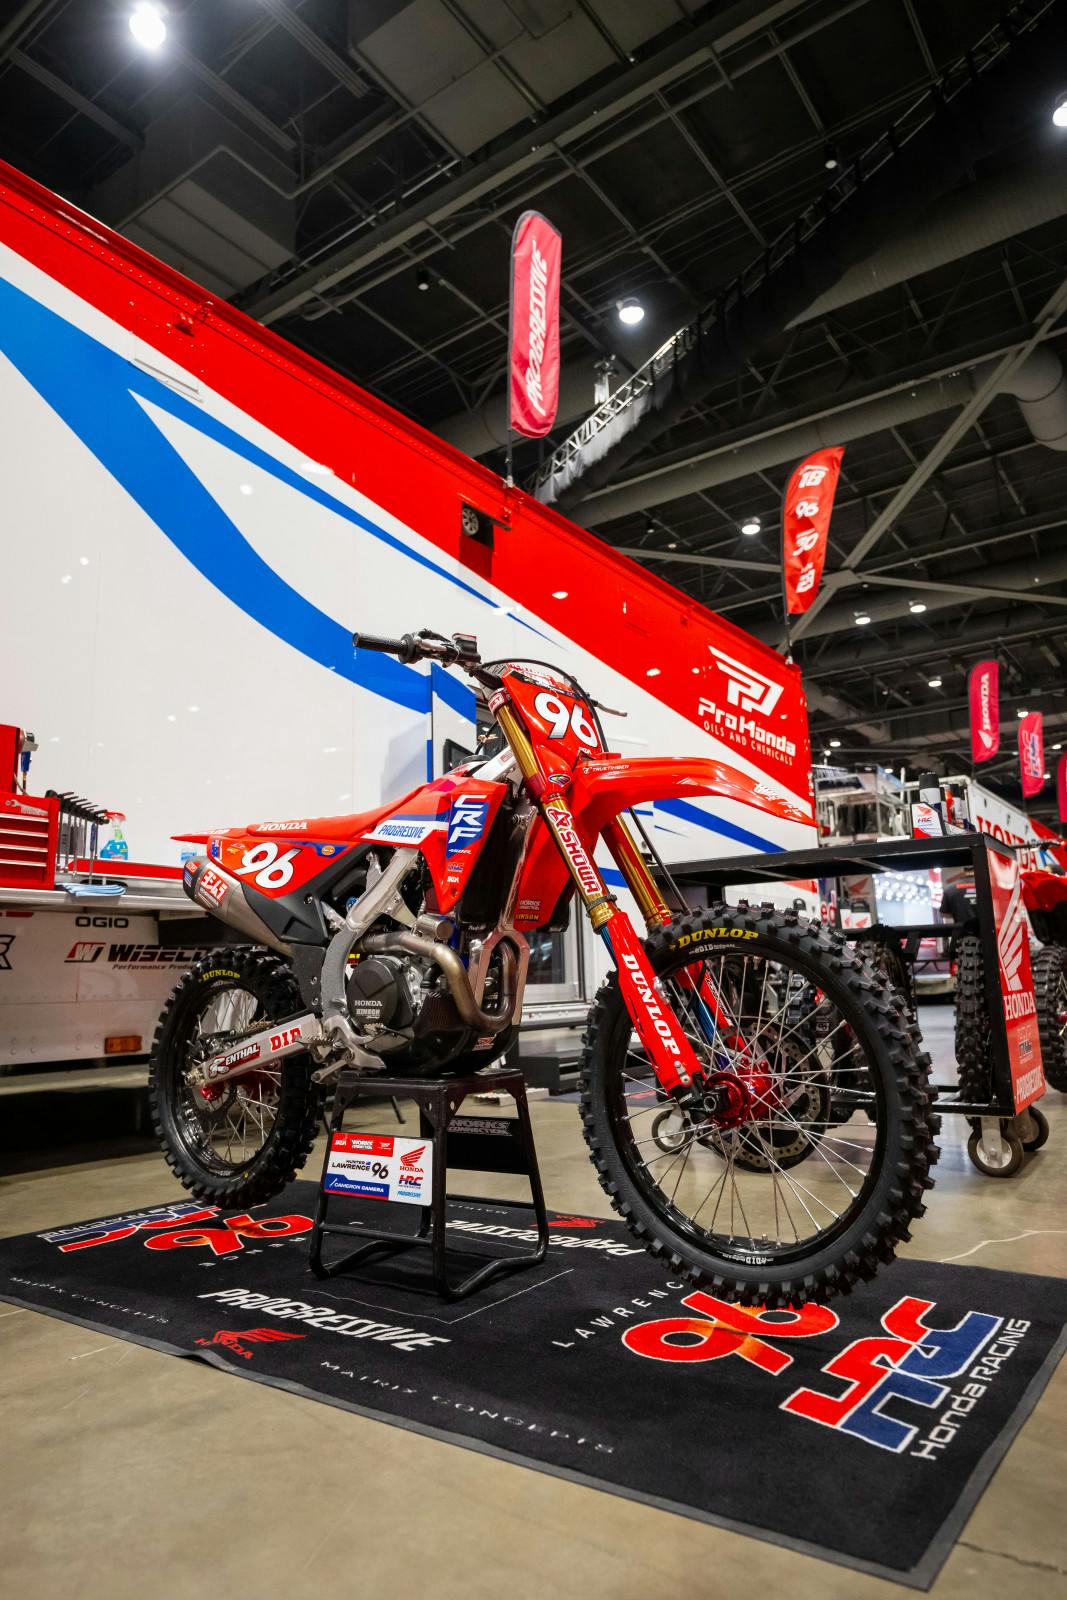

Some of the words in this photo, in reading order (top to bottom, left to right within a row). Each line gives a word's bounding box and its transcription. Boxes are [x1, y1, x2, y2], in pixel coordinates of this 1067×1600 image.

[525, 239, 548, 416] PROGRESSIVE
[795, 500, 820, 519] 96
[534, 691, 599, 748] 96
[980, 673, 991, 731] HONDA
[703, 720, 725, 737] OILS
[729, 731, 747, 746] AND
[750, 740, 793, 766] CHEMICALS
[255, 822, 308, 832] HONDA
[377, 824, 426, 839] PROGRESSIVE
[447, 794, 487, 844] CRF
[232, 841, 305, 889] 96
[560, 828, 602, 895] SHOWA
[75, 916, 129, 929] OGIO
[678, 927, 759, 949] DUNLOP
[202, 968, 241, 981] DUNLOP
[621, 952, 681, 1056] DUNLOP
[1003, 991, 1037, 1021] HONDA
[332, 1162, 371, 1172] LAWRENCE
[334, 1182, 361, 1190] CAMERON
[361, 1185, 385, 1193] CAMERA
[371, 1162, 389, 1180] 96
[398, 1174, 424, 1186] HRC
[399, 1165, 425, 1173] HONDA
[143, 1213, 315, 1256] 96
[197, 1288, 453, 1352] PROGRESSIVE
[552, 1281, 684, 1348] LAWRENC
[621, 1290, 841, 1376] 96
[779, 1295, 1004, 1454] HRC
[910, 1382, 988, 1461] Honda
[968, 1317, 1032, 1382] RACING
